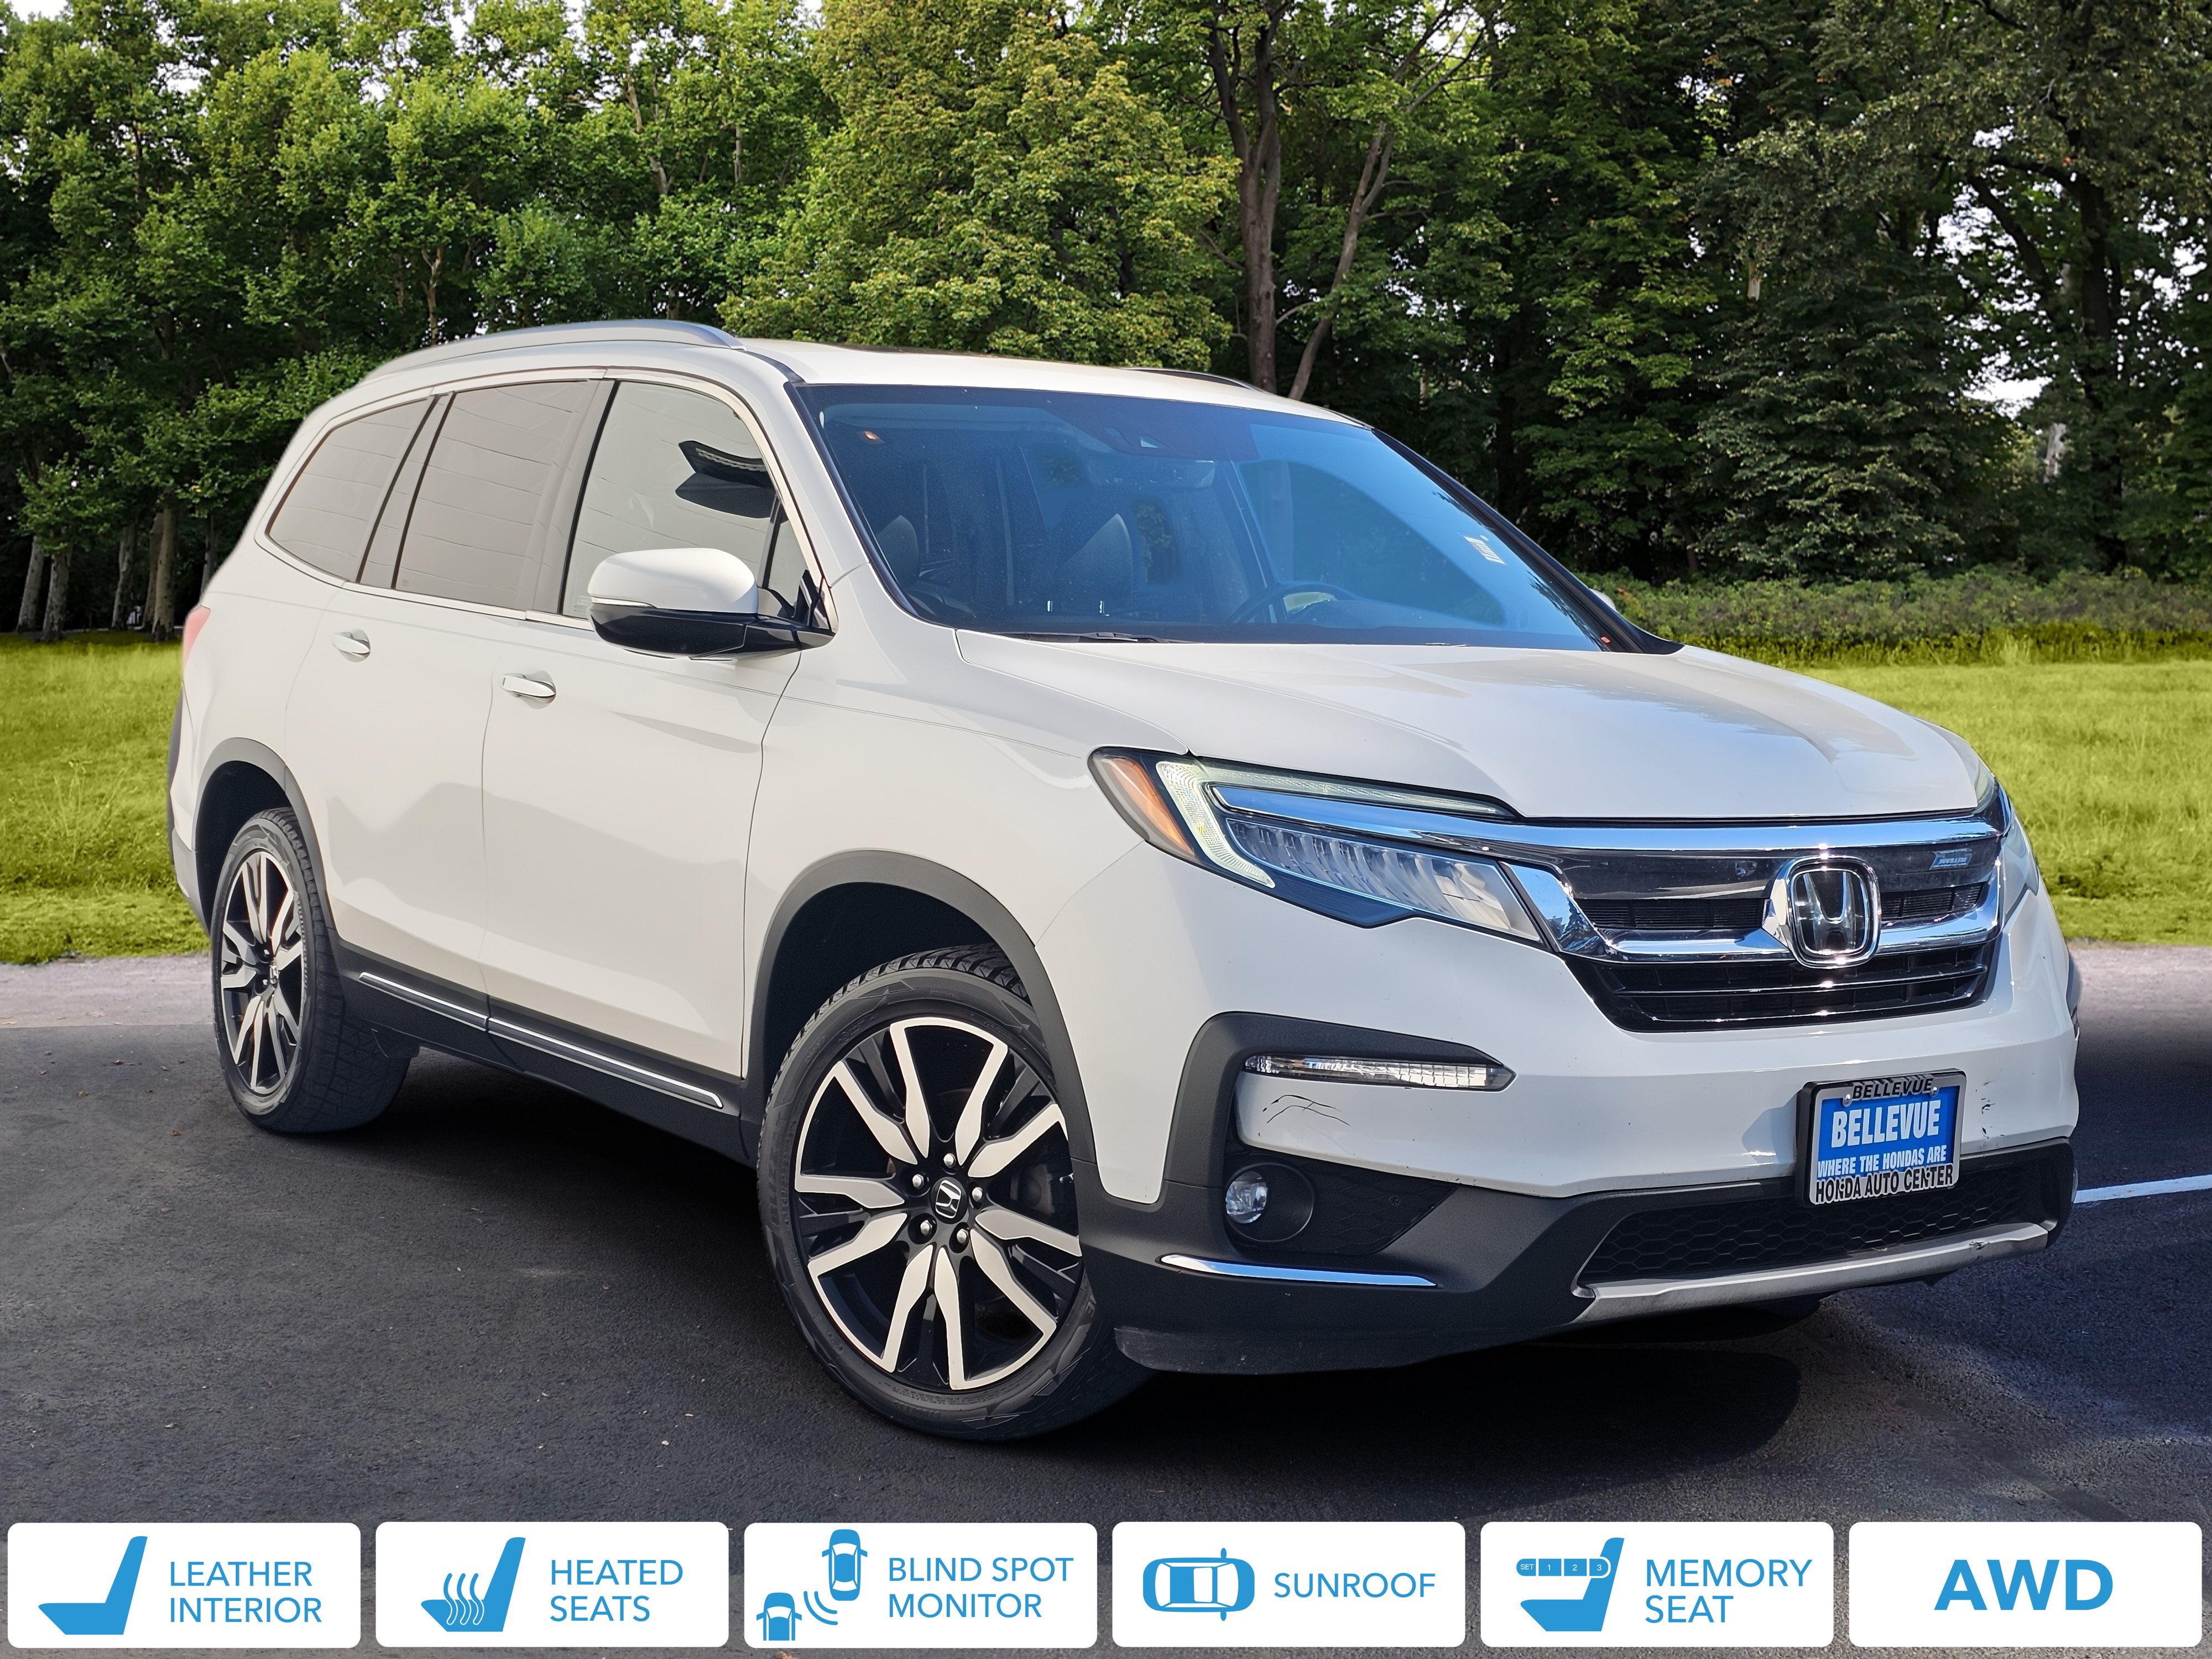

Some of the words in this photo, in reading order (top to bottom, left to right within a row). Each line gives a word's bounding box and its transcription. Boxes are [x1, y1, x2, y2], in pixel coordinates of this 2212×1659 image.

[1853, 1078, 1934, 1099] BELLEVUE
[1832, 1100, 1941, 1148] BELLEVUE
[1817, 1157, 1856, 1178] WHERE
[1860, 1154, 1879, 1173] THE
[1882, 1147, 1924, 1170] HONDAS
[1927, 1145, 1947, 1164] ARE
[1816, 1175, 1864, 1203] HONDA
[1865, 1171, 1900, 1196] AUTO
[1904, 1165, 1953, 1190] CENTER
